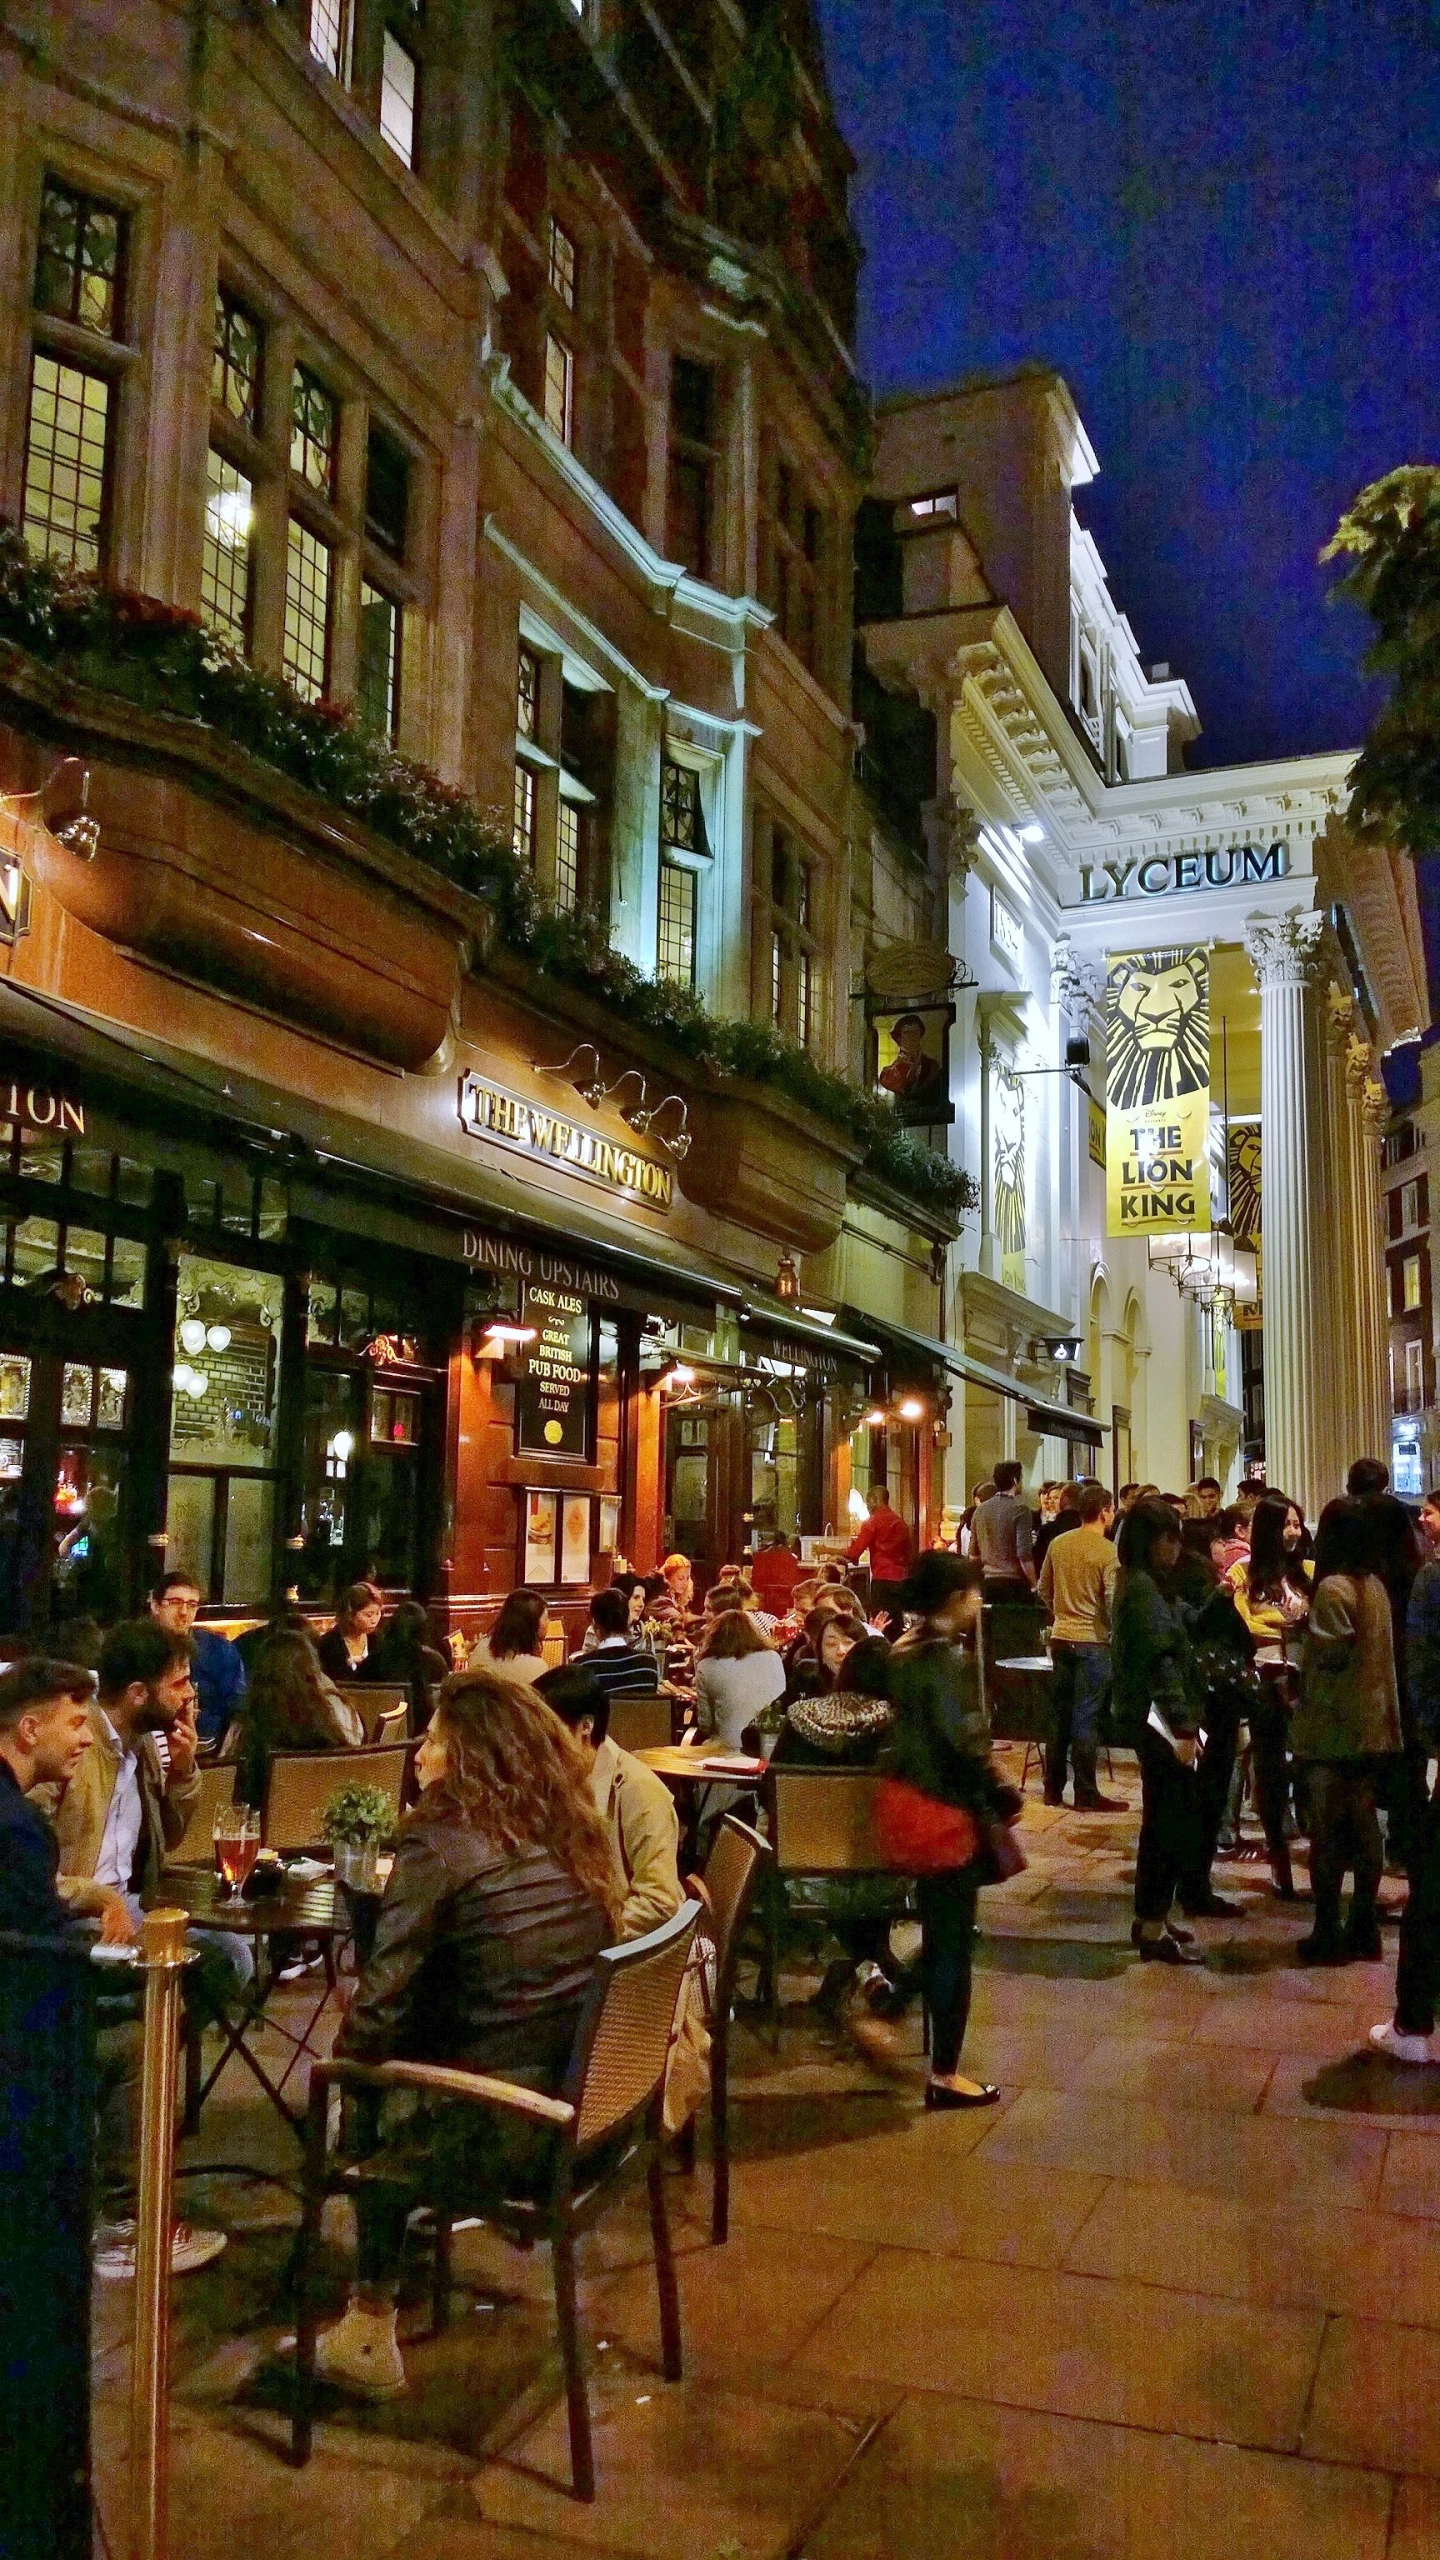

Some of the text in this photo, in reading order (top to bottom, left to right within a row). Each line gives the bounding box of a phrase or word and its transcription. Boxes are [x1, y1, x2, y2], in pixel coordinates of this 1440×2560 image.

[1079, 842, 1285, 901] LYCEUM
[471, 1083, 671, 1203] THE WELLINGTON
[1129, 1126, 1182, 1150] THE
[1122, 1159, 1193, 1184] LION
[1121, 1193, 1195, 1218] KING
[463, 1229, 619, 1299] DINING UPSTAIRS
[529, 1286, 582, 1313] CASK ALES
[542, 1329, 569, 1345] GREAT
[539, 1345, 572, 1363] BRITISH
[528, 1359, 580, 1382] PUB FOOD
[540, 1381, 570, 1396] SERVED
[538, 1397, 569, 1413] ALL DAY
